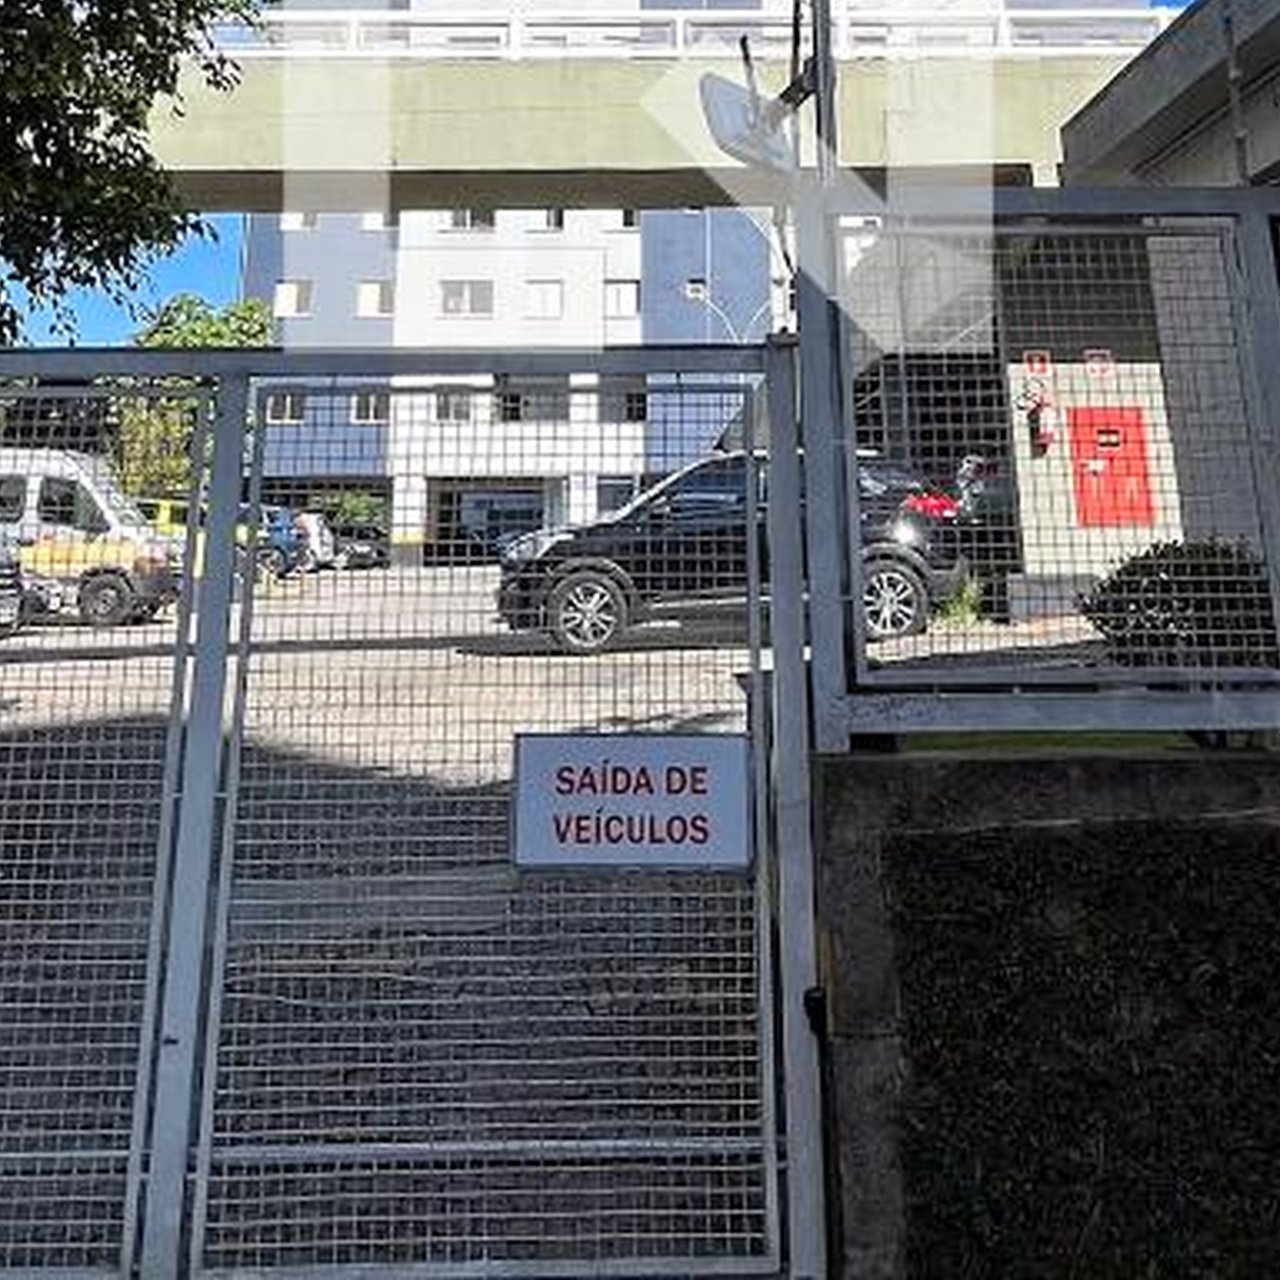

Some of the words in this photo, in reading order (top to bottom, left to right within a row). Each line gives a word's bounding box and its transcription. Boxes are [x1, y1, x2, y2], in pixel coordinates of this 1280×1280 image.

[555, 759, 654, 795] SAÍDA
[666, 767, 708, 795] DE
[553, 806, 710, 845] VEÍCULOS
